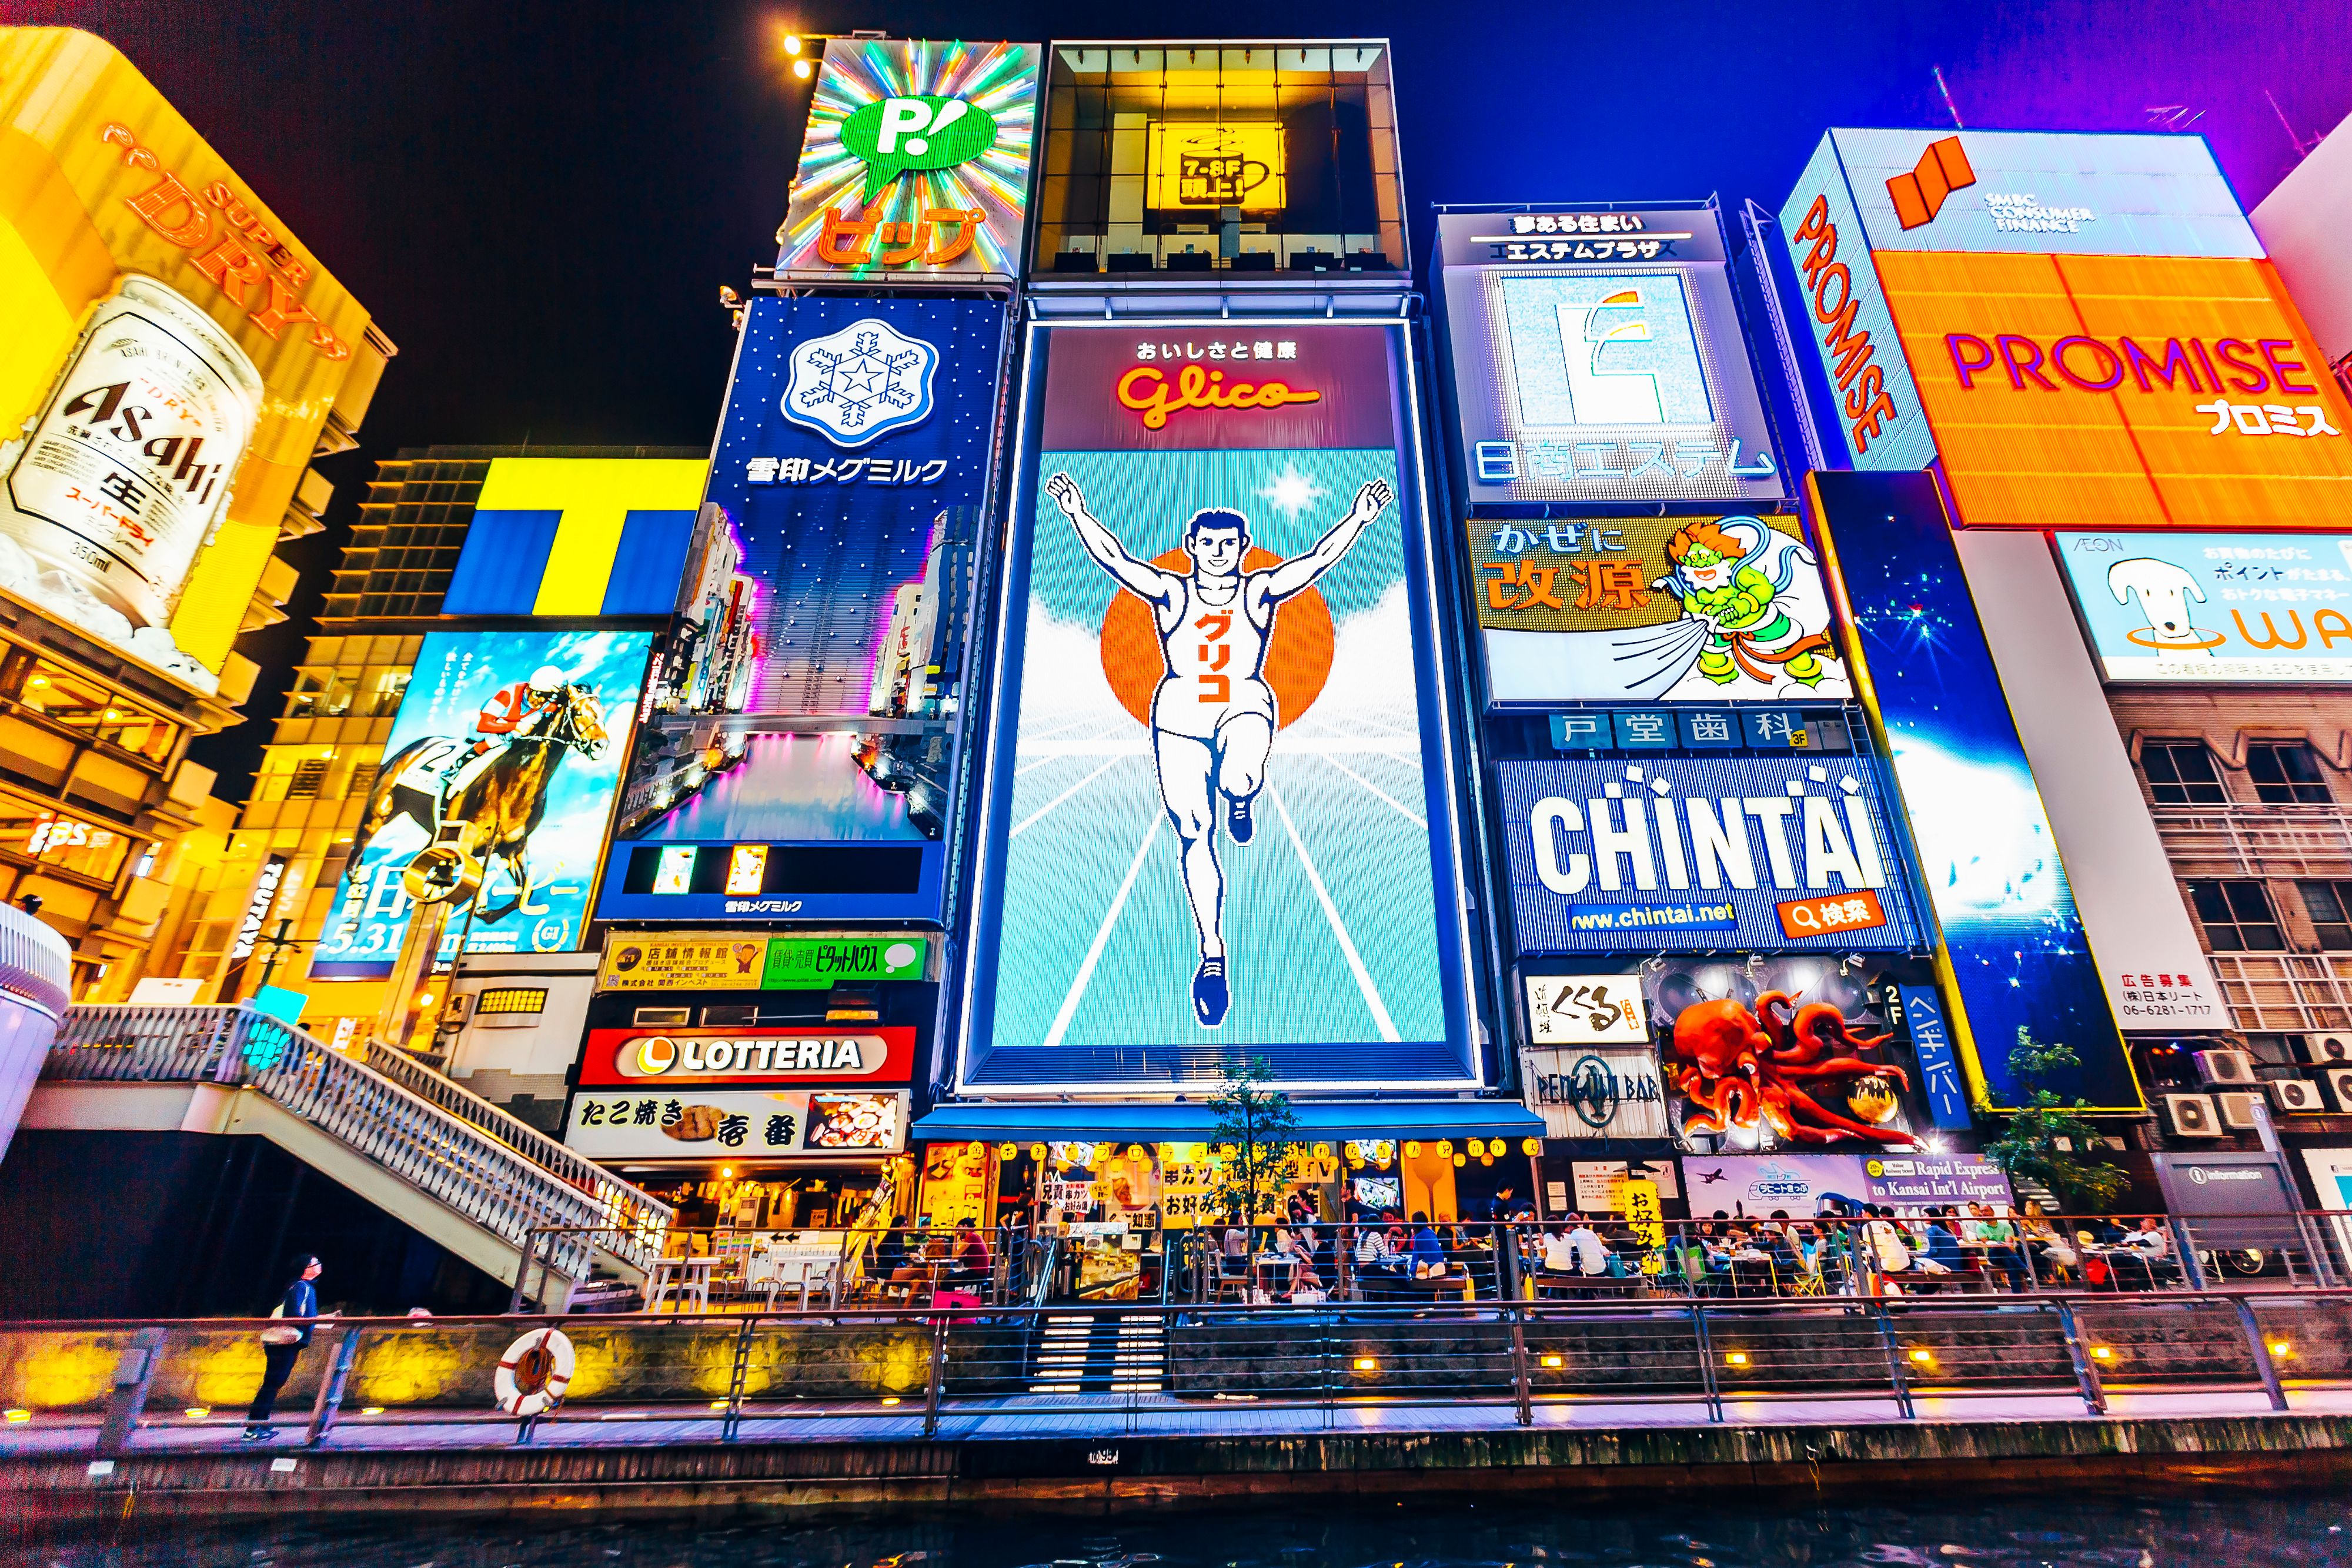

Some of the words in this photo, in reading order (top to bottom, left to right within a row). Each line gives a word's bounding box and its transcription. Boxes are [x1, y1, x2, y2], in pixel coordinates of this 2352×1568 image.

[1984, 192, 2038, 207] SMBC
[1512, 215, 1643, 233] 夢ある住まい
[1990, 206, 2096, 222] CONSUMER
[1995, 218, 2080, 233] FINANCE
[203, 180, 312, 288] SUPER
[817, 207, 985, 265] ピップ
[1506, 241, 1660, 260] エステムプラザ
[1794, 194, 1897, 454] PROMISE
[1137, 342, 1297, 360] おいしさと健康
[1943, 332, 2320, 395] PROMISE
[1117, 365, 1322, 430] Glico
[2195, 400, 2340, 436] プロミス
[64, 380, 222, 505] Asahi
[746, 457, 947, 483] 雪印メグミルク
[99, 472, 146, 516] 生
[1493, 523, 1626, 554] かぜに
[1483, 560, 1651, 610] 改源
[1194, 609, 1234, 703] グリコ
[1564, 712, 1792, 743] 戸堂歯科
[1792, 733, 1806, 746] 3F
[1530, 795, 1886, 895] CHINTAI
[725, 901, 803, 913] 雪印メグミルク
[1820, 899, 1871, 926] 検索
[648, 948, 728, 959] 店舗情報館
[816, 945, 878, 972] ピタットハウス
[2122, 974, 2193, 987] 広告募集
[1551, 985, 1621, 1031] くくる
[2123, 1005, 2211, 1015] 06-6281-1717
[682, 1040, 862, 1069] LOTTERIA
[1910, 996, 1957, 1115] ペンギンバー
[1624, 1072, 1661, 1104] BAR
[580, 1101, 684, 1126] たこ焼き
[1164, 1165, 1212, 1186] 串カツ
[1915, 1161, 1953, 1179] Rapid
[1955, 1160, 2000, 1179] Express
[2206, 1169, 2263, 1181] information
[1872, 1185, 1885, 1196] to
[1887, 1181, 1930, 1196] Kansai
[1960, 1181, 2005, 1199] Airport
